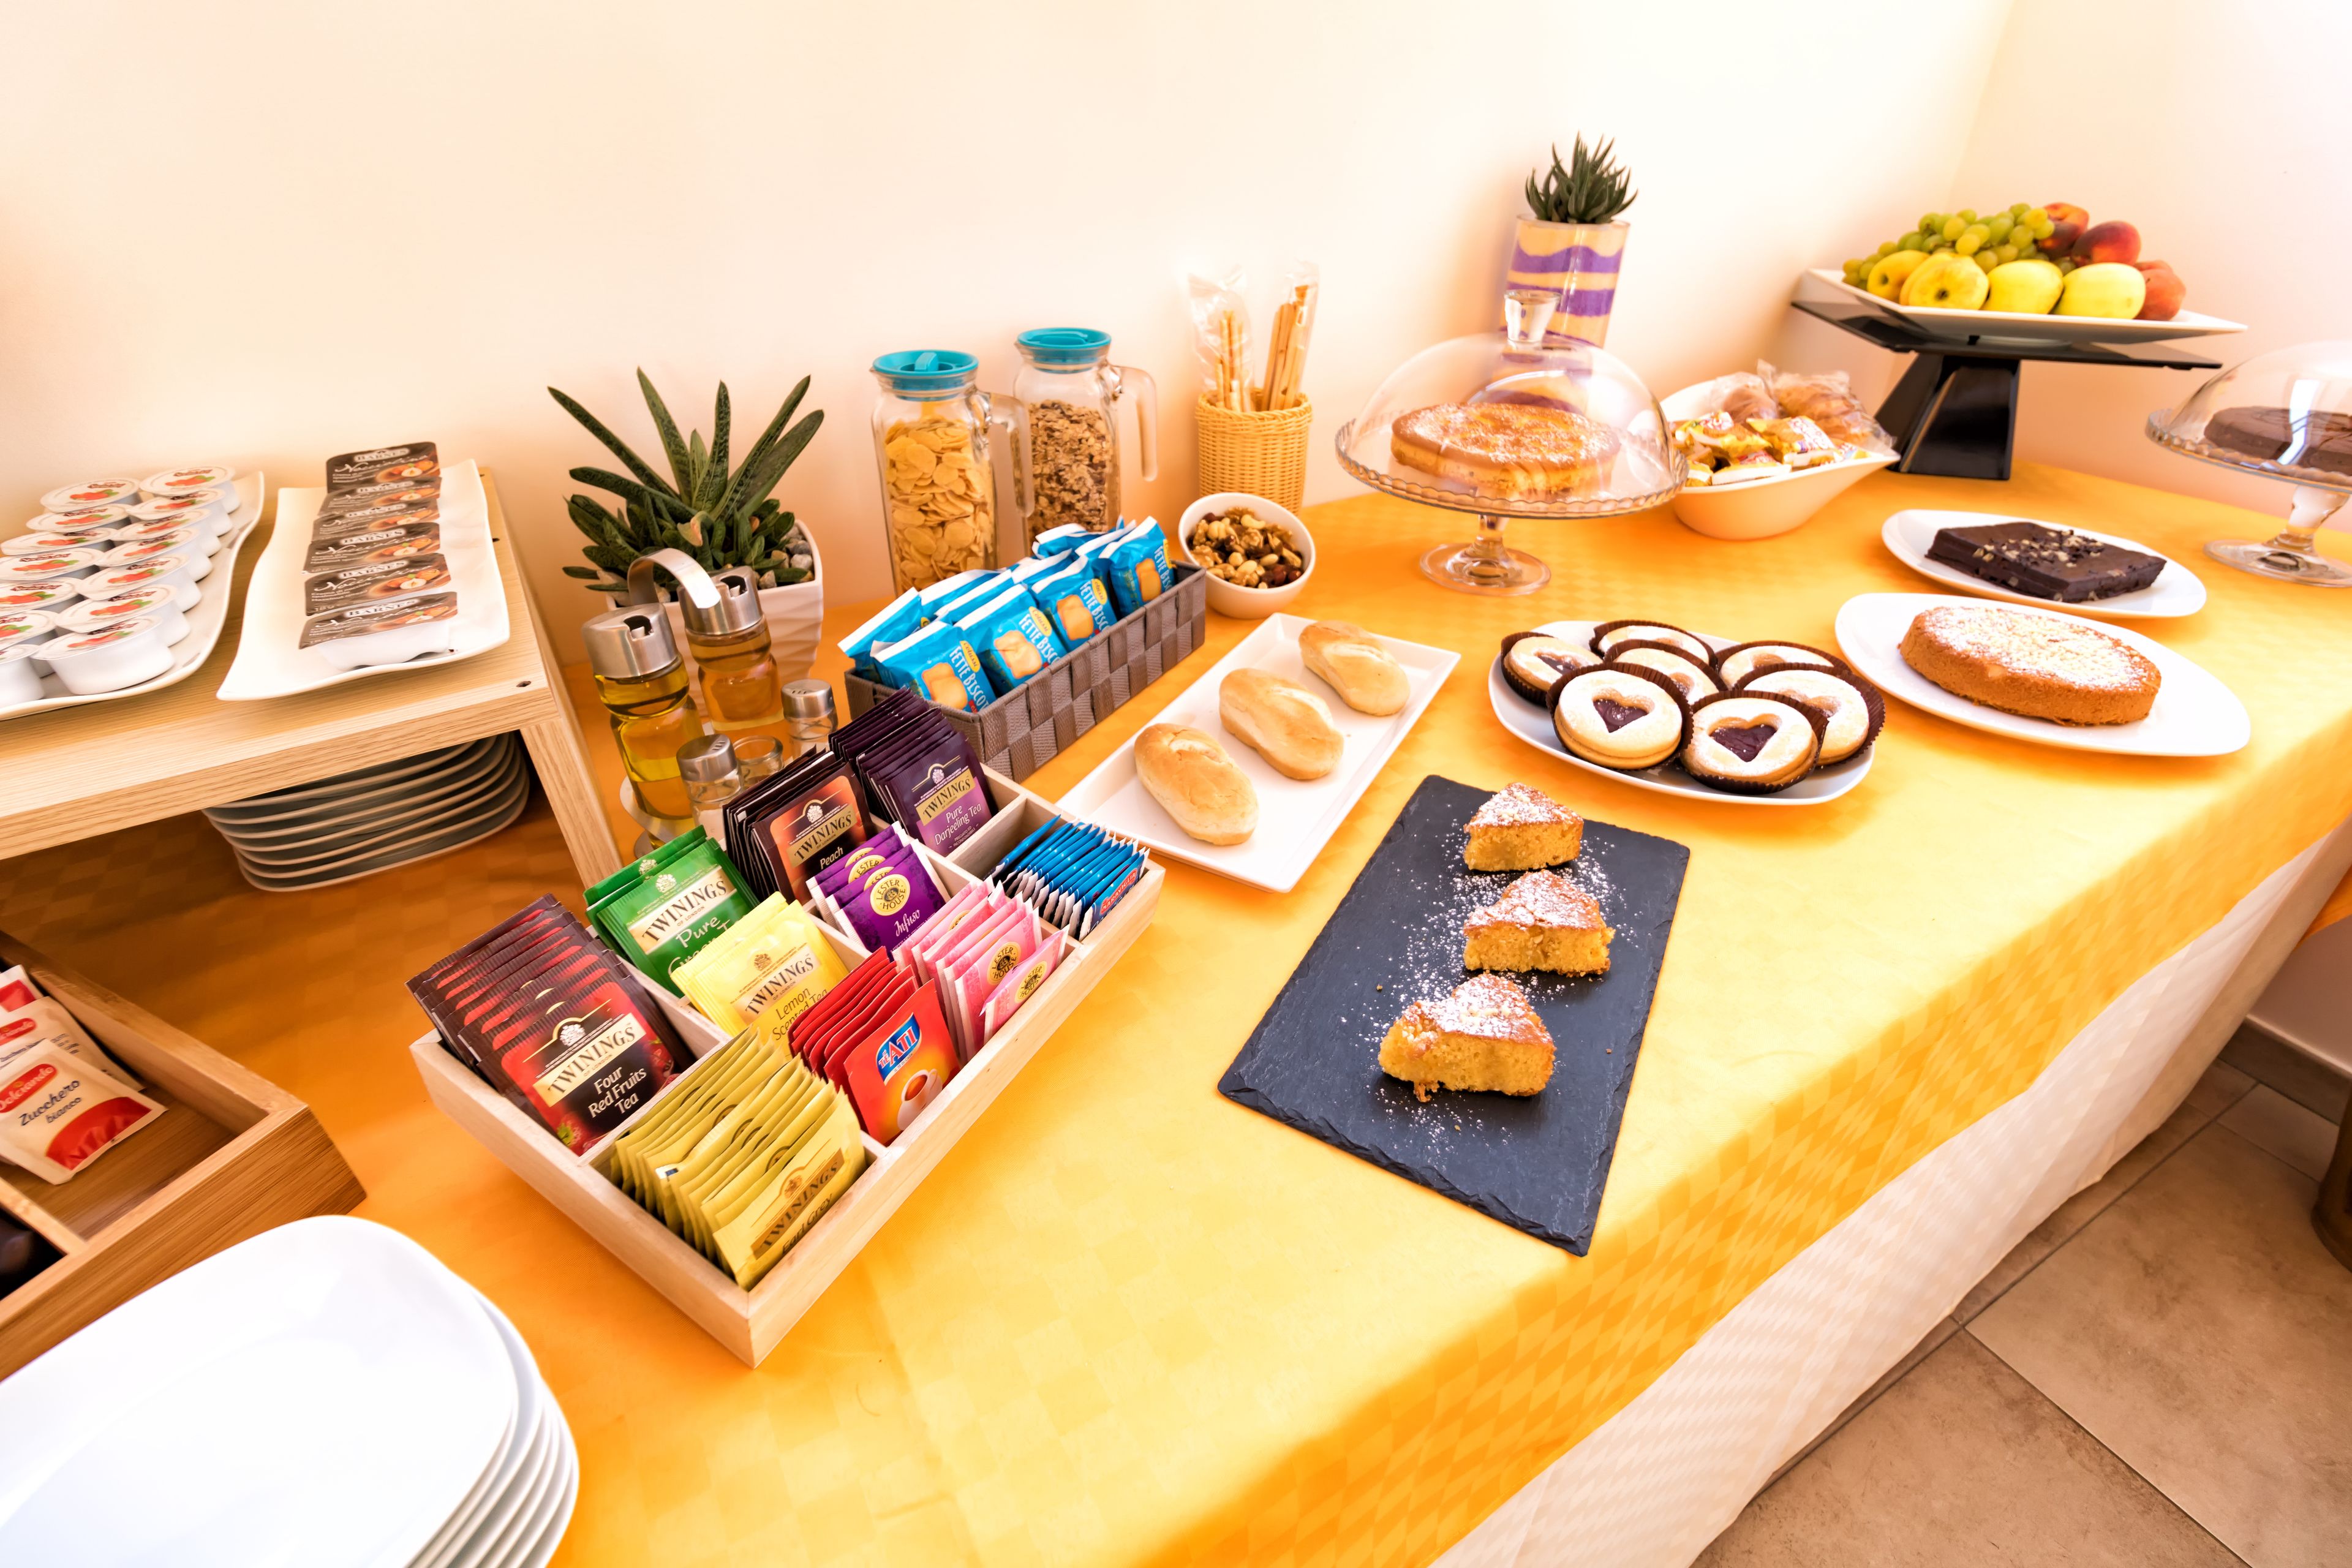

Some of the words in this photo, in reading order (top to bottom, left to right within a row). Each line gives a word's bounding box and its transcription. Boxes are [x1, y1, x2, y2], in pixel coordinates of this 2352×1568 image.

[344, 531, 403, 543] BARNES
[342, 561, 404, 578] BARNES
[349, 600, 417, 616] BARNES
[1079, 580, 1101, 611] FETTE
[1019, 613, 1042, 644] FETTE
[949, 646, 970, 678] FETTE
[923, 778, 970, 819] TWININGS
[946, 805, 962, 823] Pure
[794, 814, 851, 860] TWININGS
[934, 813, 970, 845] Darjeeling
[968, 803, 981, 817] Tea
[820, 846, 843, 870] Peach
[876, 879, 900, 900] LESTER
[883, 889, 905, 910] HOUSE
[1102, 872, 1136, 910] MARAVIGLIA
[642, 880, 727, 941] TWININGS
[685, 906, 705, 921] LONDON
[894, 910, 920, 937] Infuso
[676, 916, 720, 948] Pure
[992, 946, 1013, 970] LESTER
[993, 957, 1017, 979] HOUSE
[745, 957, 814, 1015] TWININGS
[1021, 965, 1042, 989] LESTER
[775, 987, 810, 1020] Lemon
[548, 1027, 636, 1094] TWININGS
[889, 1026, 918, 1068] ATI
[588, 1092, 614, 1118] Red
[611, 1068, 647, 1100] Fruits
[594, 1066, 622, 1095] Four
[18, 1080, 80, 1126] Zucchero
[45, 1096, 82, 1123] bianco
[614, 1092, 639, 1114] Tea
[760, 1161, 838, 1248] TWININGS
[782, 1222, 805, 1254] Earl
[807, 1193, 833, 1226] Grey
